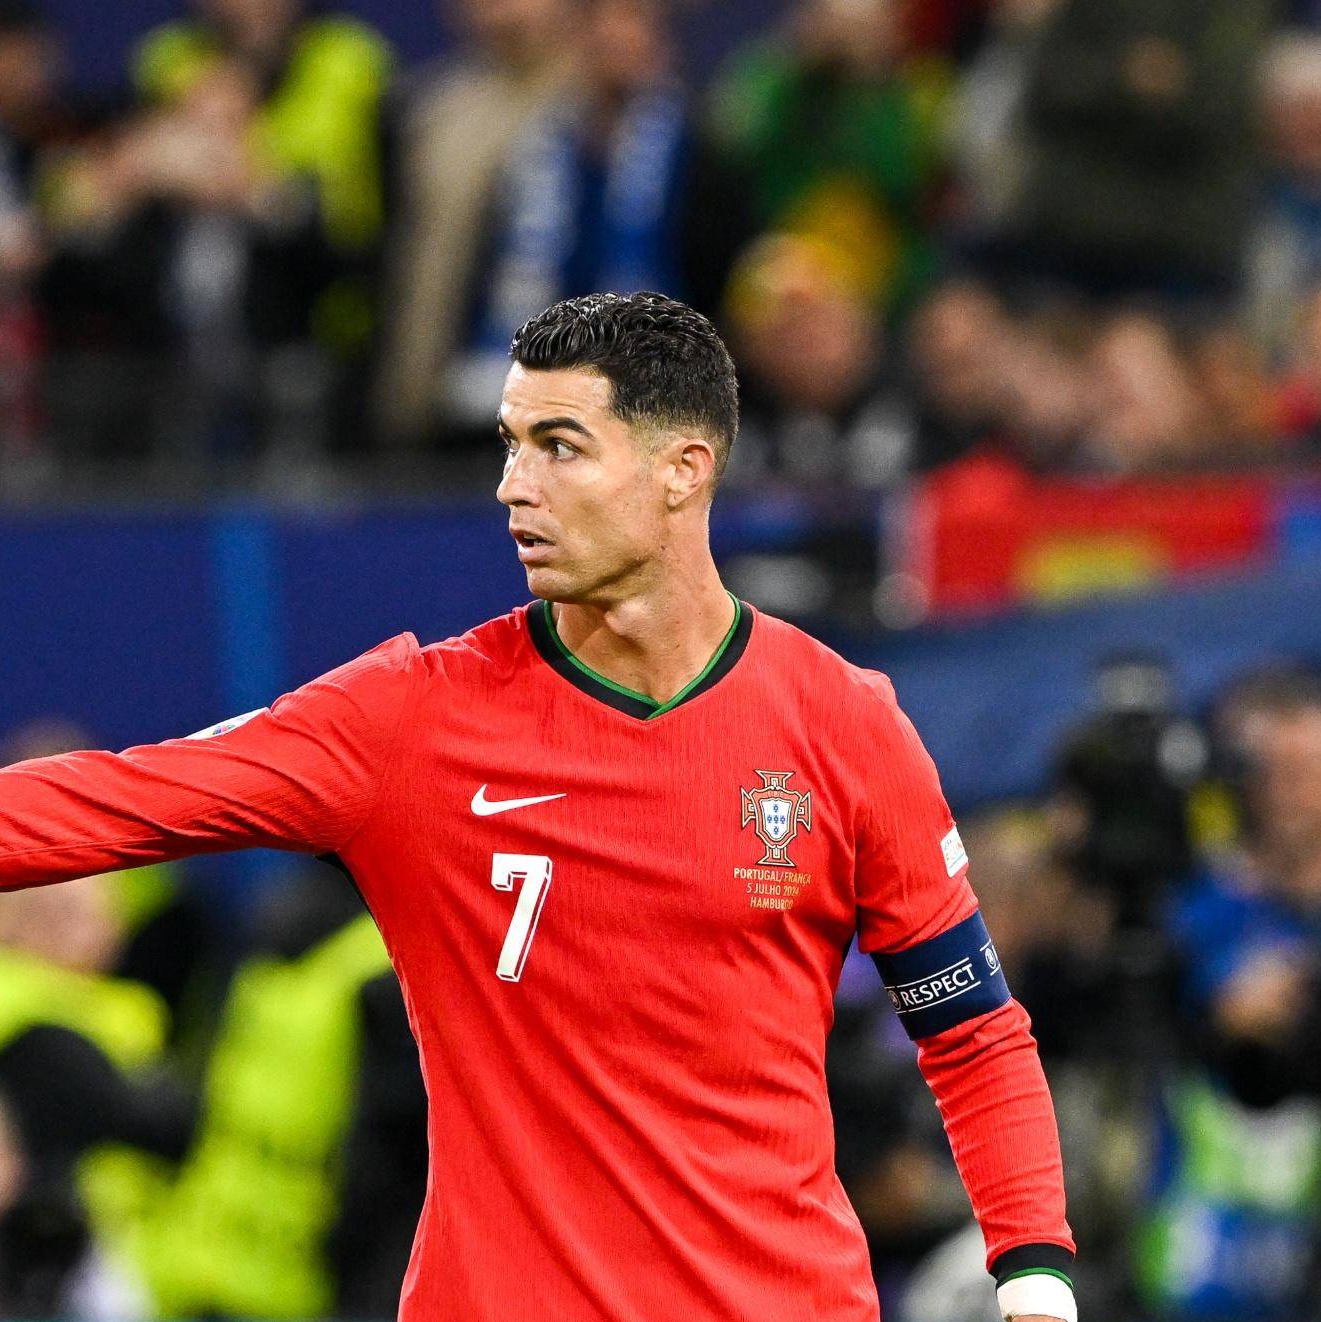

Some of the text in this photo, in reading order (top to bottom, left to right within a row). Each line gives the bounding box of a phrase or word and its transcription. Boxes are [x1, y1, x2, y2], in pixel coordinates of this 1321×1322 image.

[746, 882, 753, 894] 5
[754, 883, 781, 896] JULHO
[491, 853, 553, 982] 7
[900, 963, 975, 1007] RESPECT
